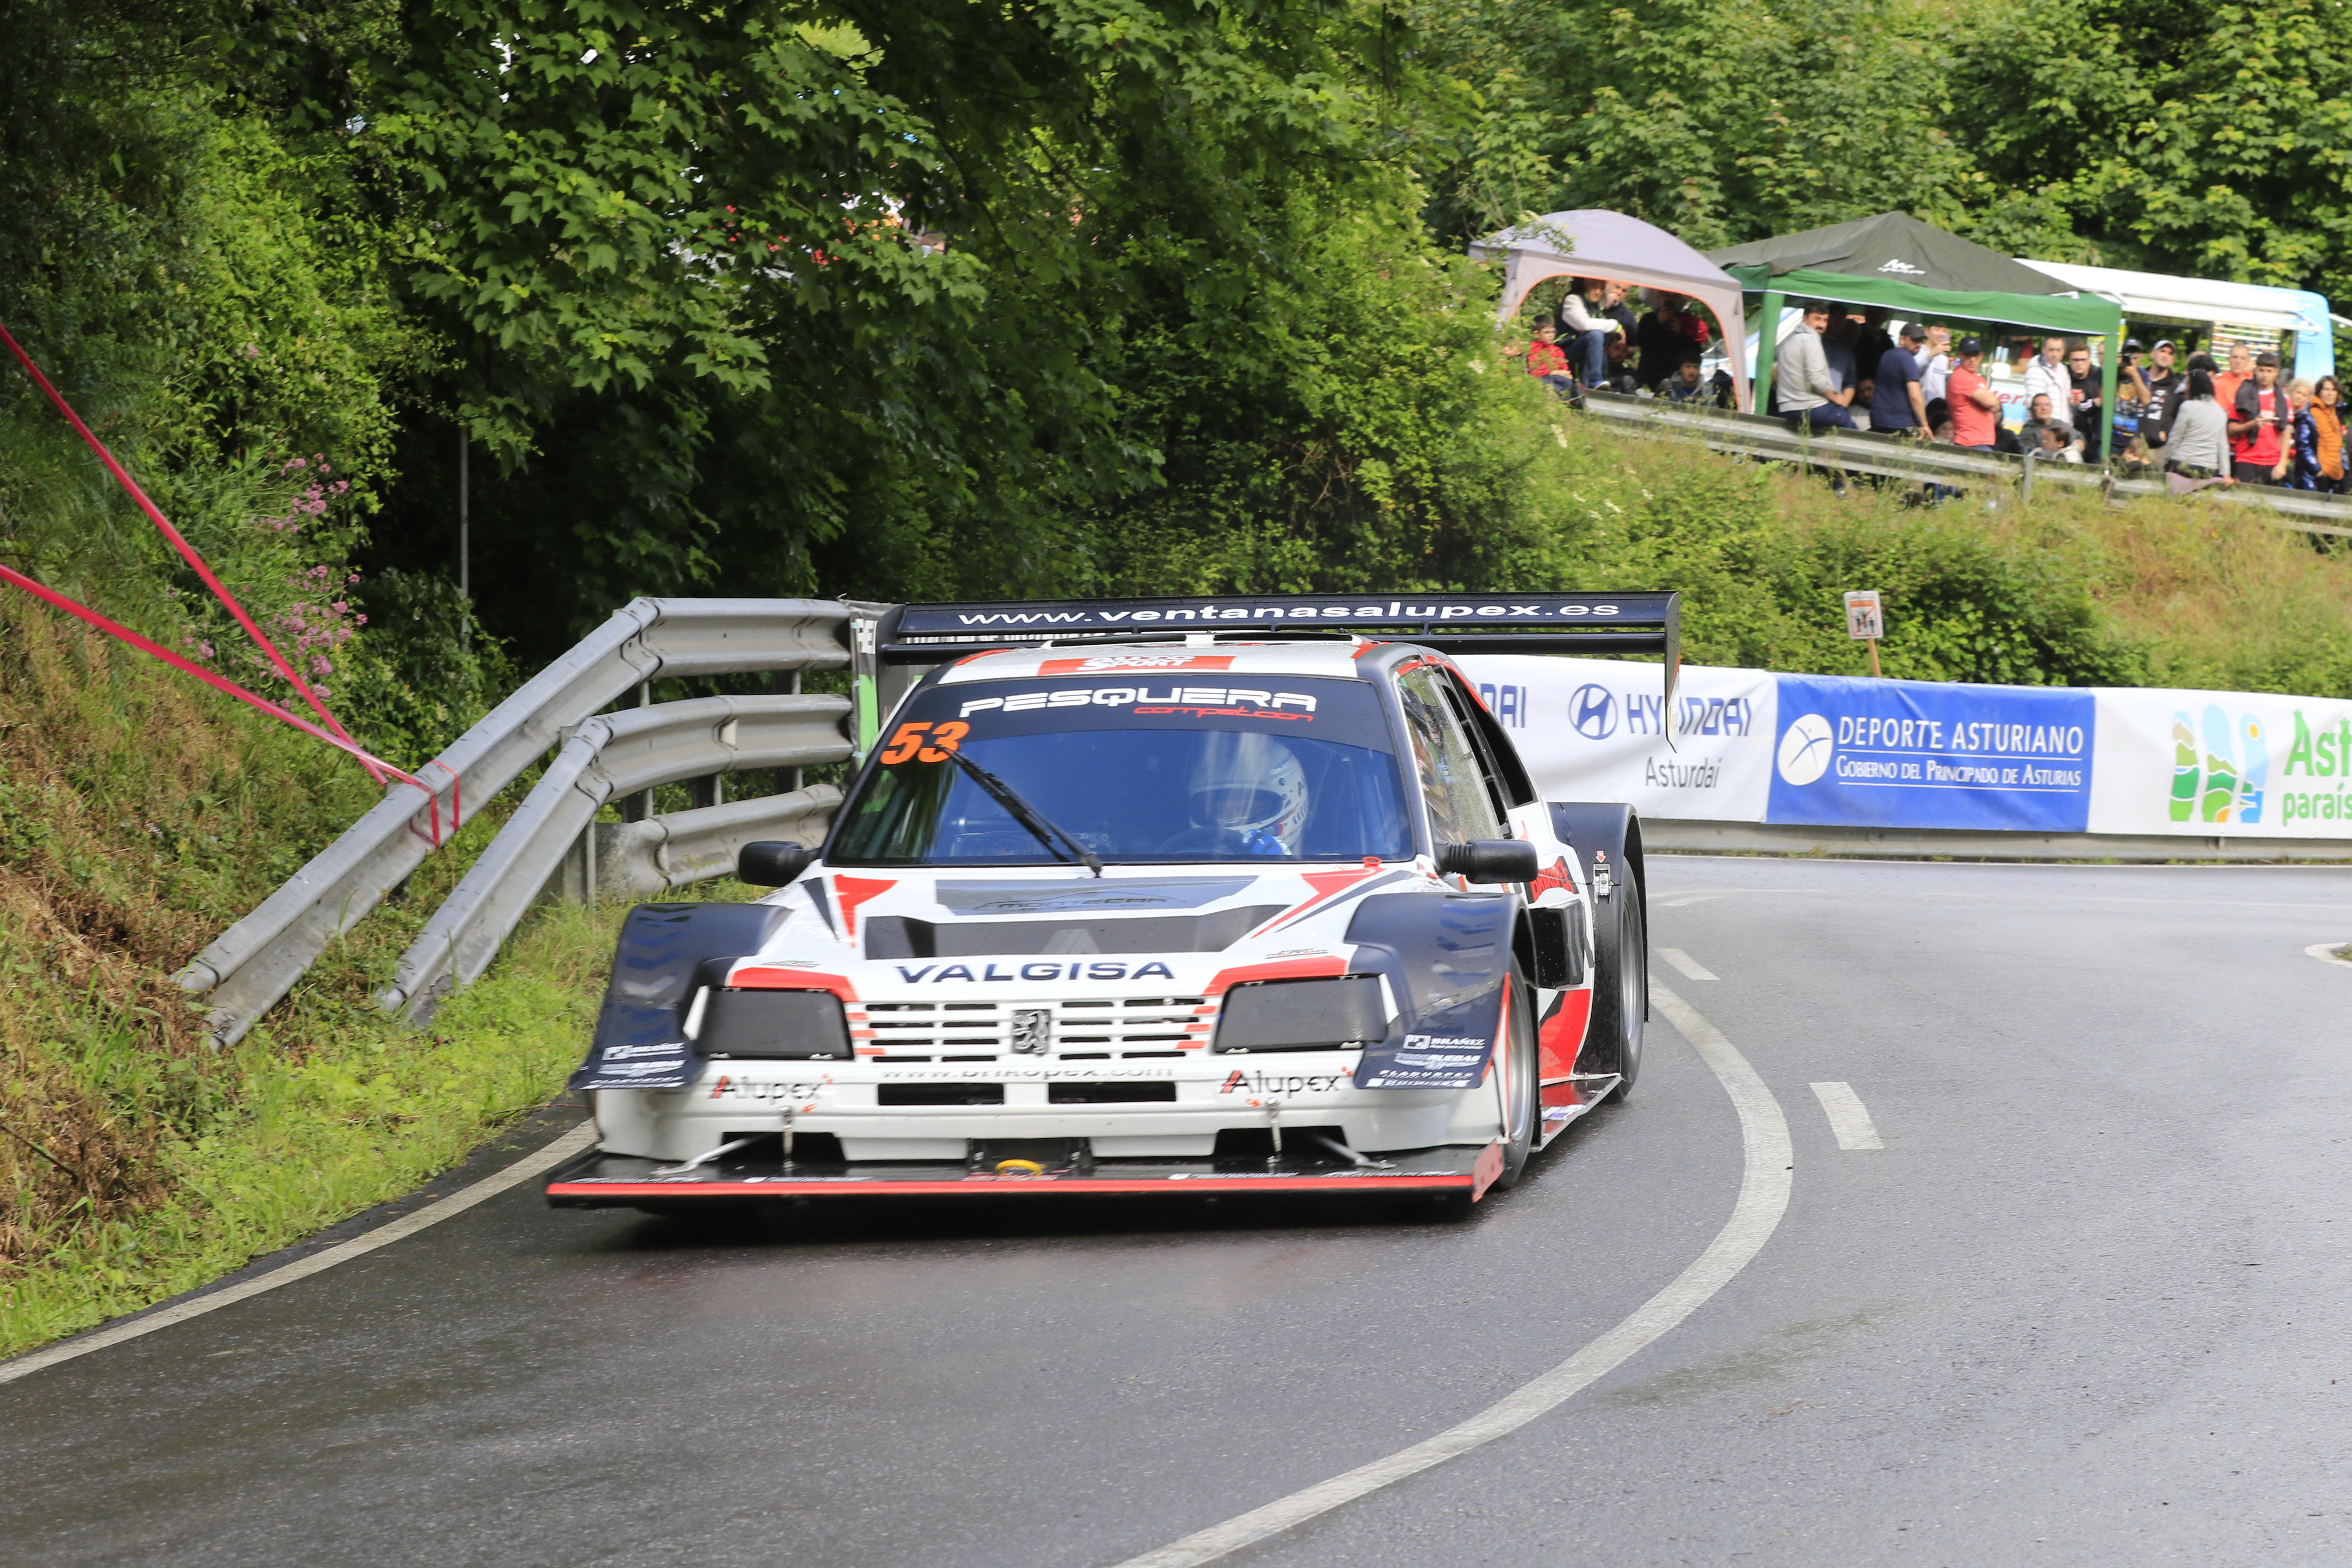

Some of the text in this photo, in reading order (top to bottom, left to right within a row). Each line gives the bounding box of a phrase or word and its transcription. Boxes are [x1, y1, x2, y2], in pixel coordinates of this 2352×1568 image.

[958, 602, 1620, 625] www.ventanasalupex.es
[1076, 659, 1193, 671] SPORT
[959, 687, 1317, 718] PESQUERA
[1472, 682, 1526, 729] DAI
[880, 721, 970, 765] 53
[1838, 716, 2084, 754] DEPORTE ASTURIANO
[1645, 756, 1722, 788] Asturdai
[896, 962, 1175, 983] VALGISA
[1219, 1070, 1341, 1099] Alupex
